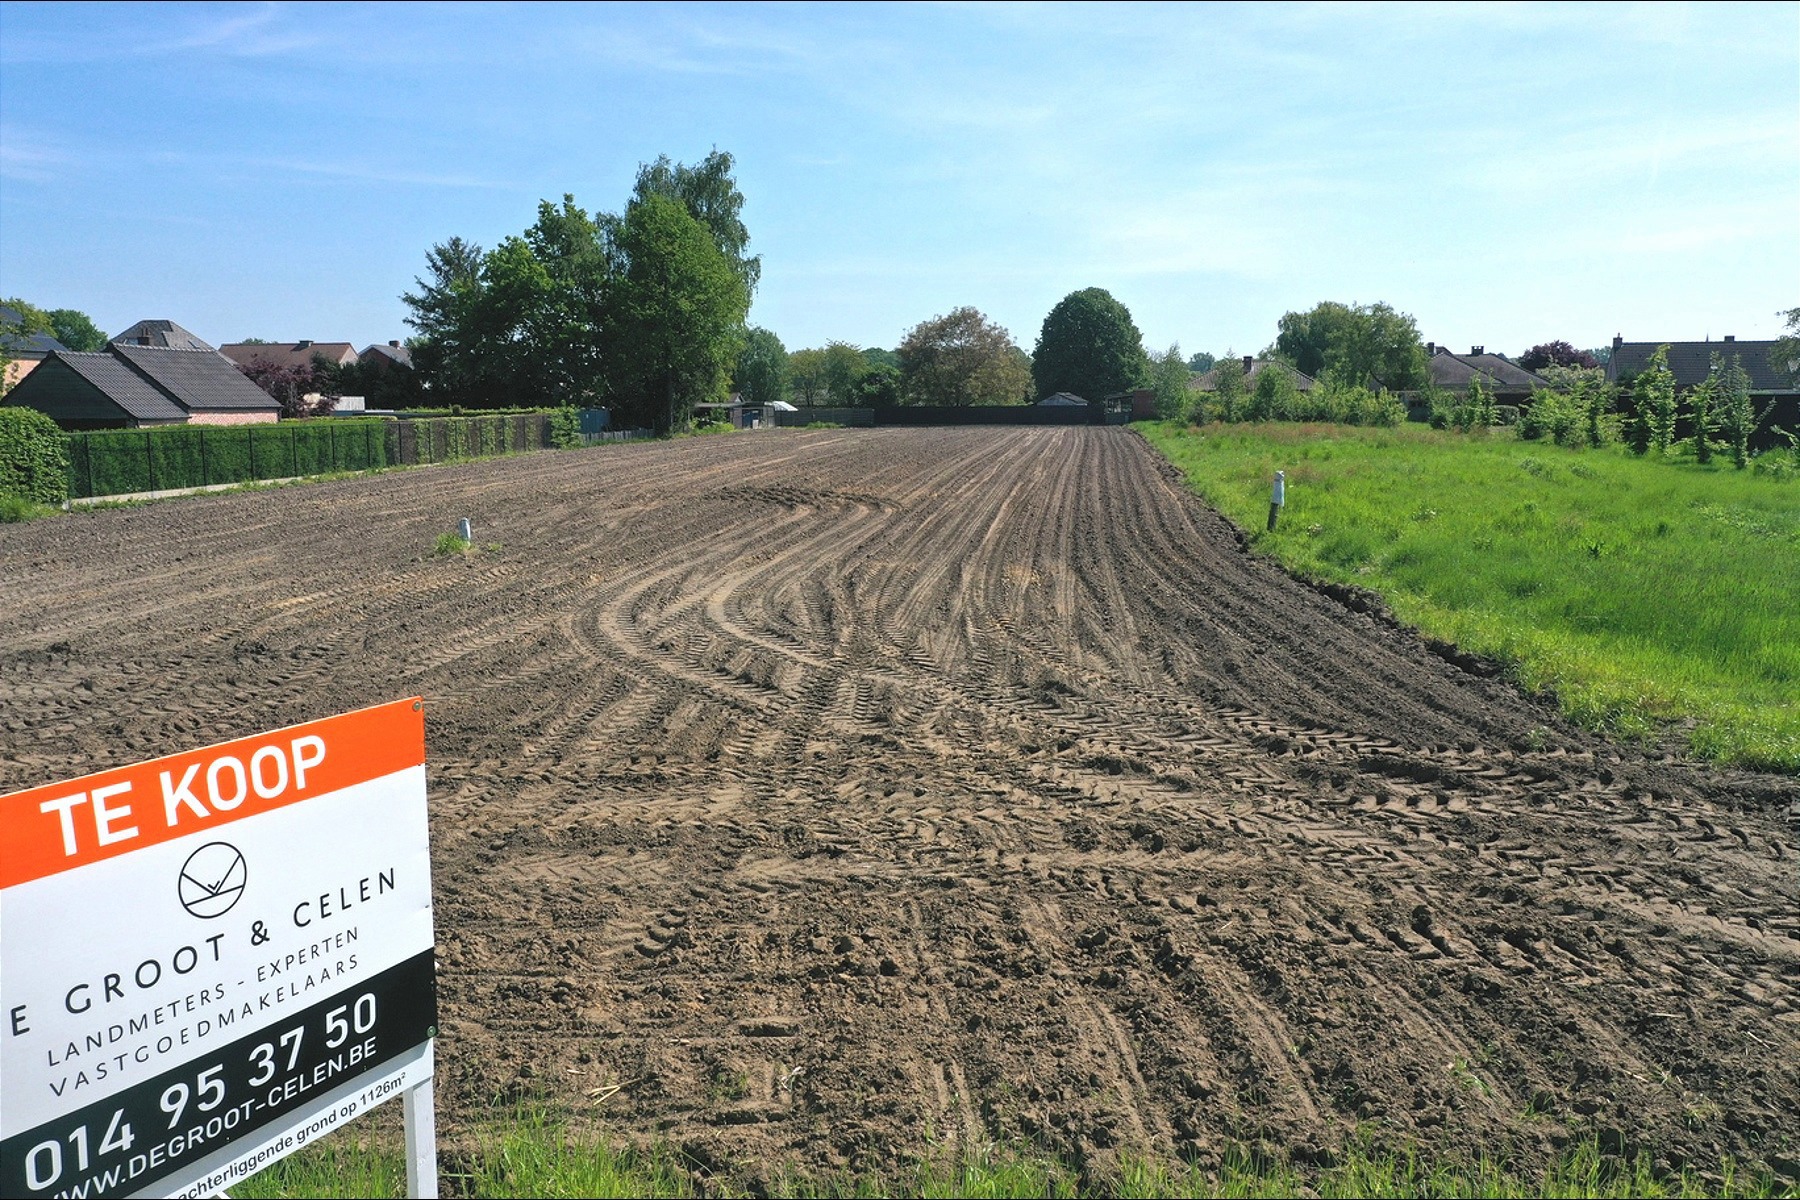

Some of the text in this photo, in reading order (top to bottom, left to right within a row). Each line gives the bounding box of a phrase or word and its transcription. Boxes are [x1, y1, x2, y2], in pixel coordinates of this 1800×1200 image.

[40, 734, 327, 856] TE KOOP
[47, 982, 225, 1067] LANDMETERS
[257, 926, 359, 982] EXPERTEN
[65, 933, 225, 1014] GROOT
[251, 920, 270, 946] &
[293, 867, 396, 928] CELEN
[25, 992, 378, 1191] 014 95 37 50
[49, 954, 360, 1097] VASTGOEDMAKELAARS
[53, 1036, 377, 1199] WW.DEGROOT-CELEN.BE
[297, 1113, 338, 1144] grond
[340, 1101, 358, 1117] op
